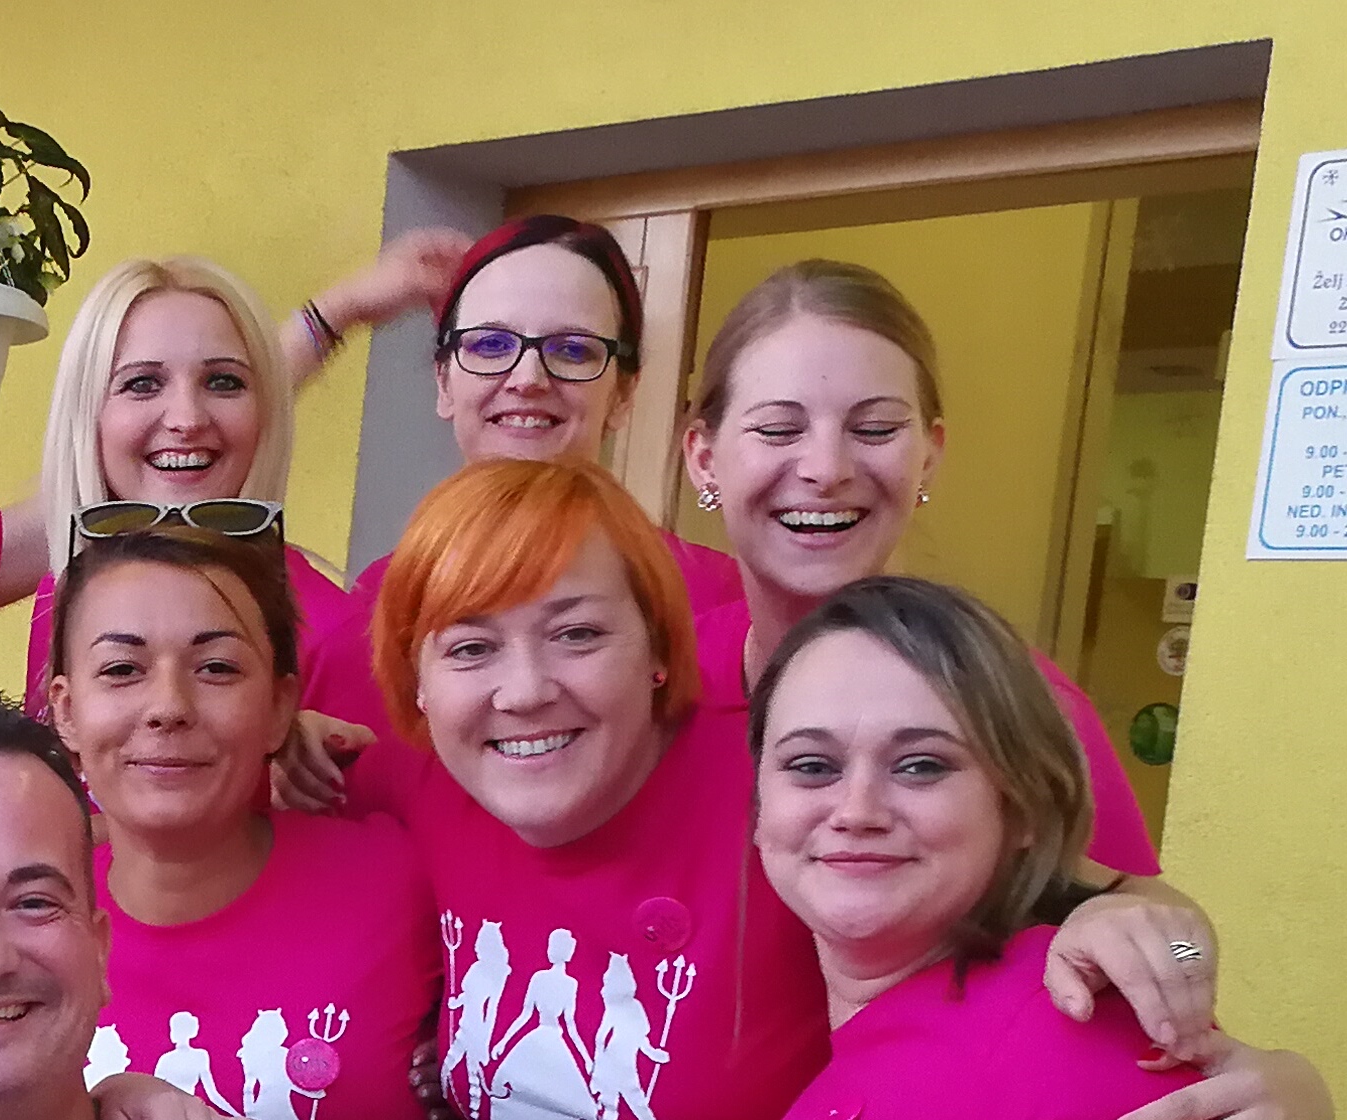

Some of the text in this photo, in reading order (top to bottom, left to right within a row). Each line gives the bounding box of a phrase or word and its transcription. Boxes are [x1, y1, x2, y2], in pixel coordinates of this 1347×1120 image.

[1329, 226, 1347, 242] O
[1300, 379, 1347, 397] ODP
[1305, 445, 1338, 459] 9.00
[1322, 464, 1347, 478] PE
[1302, 484, 1334, 498] 9.00
[1296, 524, 1328, 538] 9.00
